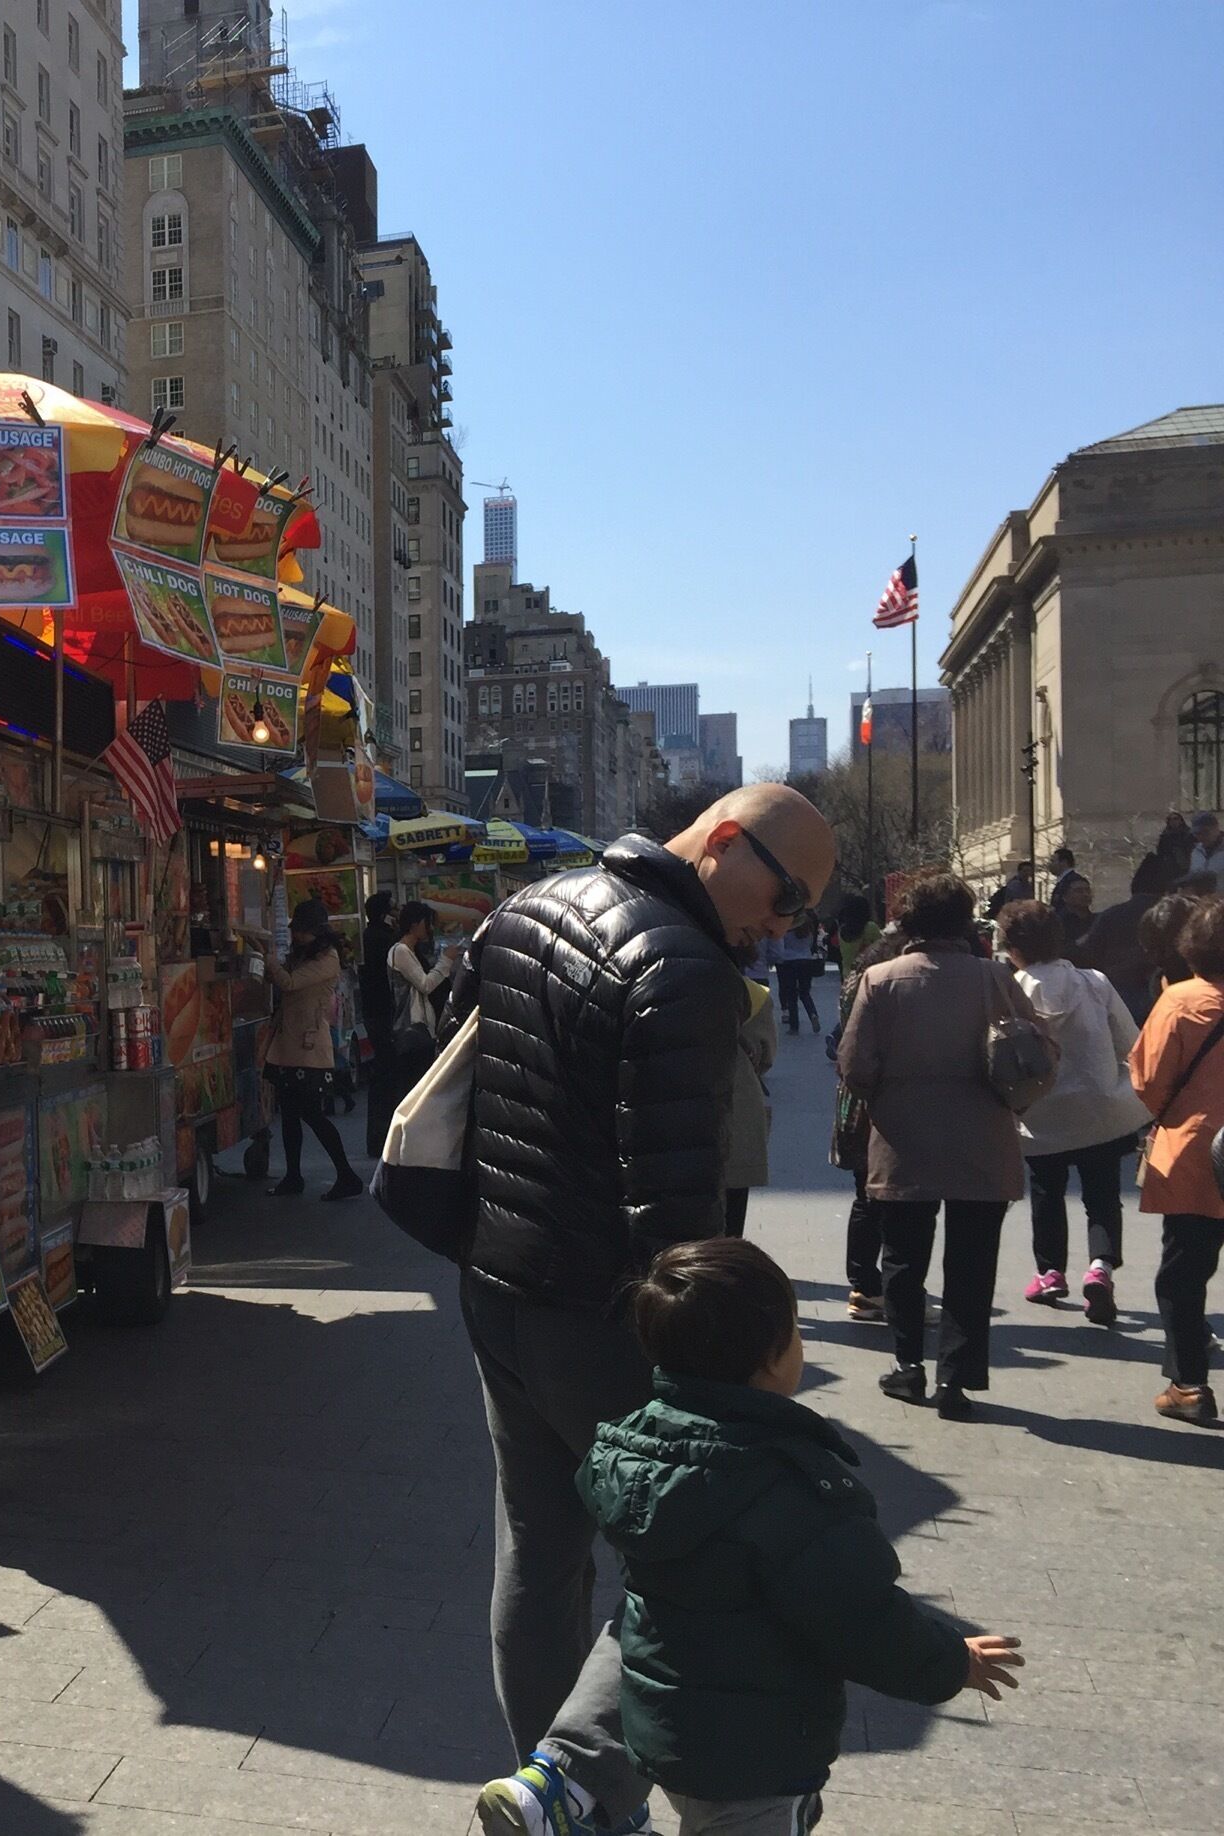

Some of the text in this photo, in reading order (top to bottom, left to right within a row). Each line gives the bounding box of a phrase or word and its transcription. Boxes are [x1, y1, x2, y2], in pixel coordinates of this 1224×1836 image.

[139, 447, 212, 490] JUMBO HOT DOG
[255, 496, 284, 517] DOG
[124, 559, 198, 597] CHILI DOG
[214, 580, 271, 607] HOT DOG
[279, 606, 314, 624] SAUSAGE
[227, 677, 293, 699] CHII DOG
[395, 825, 462, 847] SABRETT
